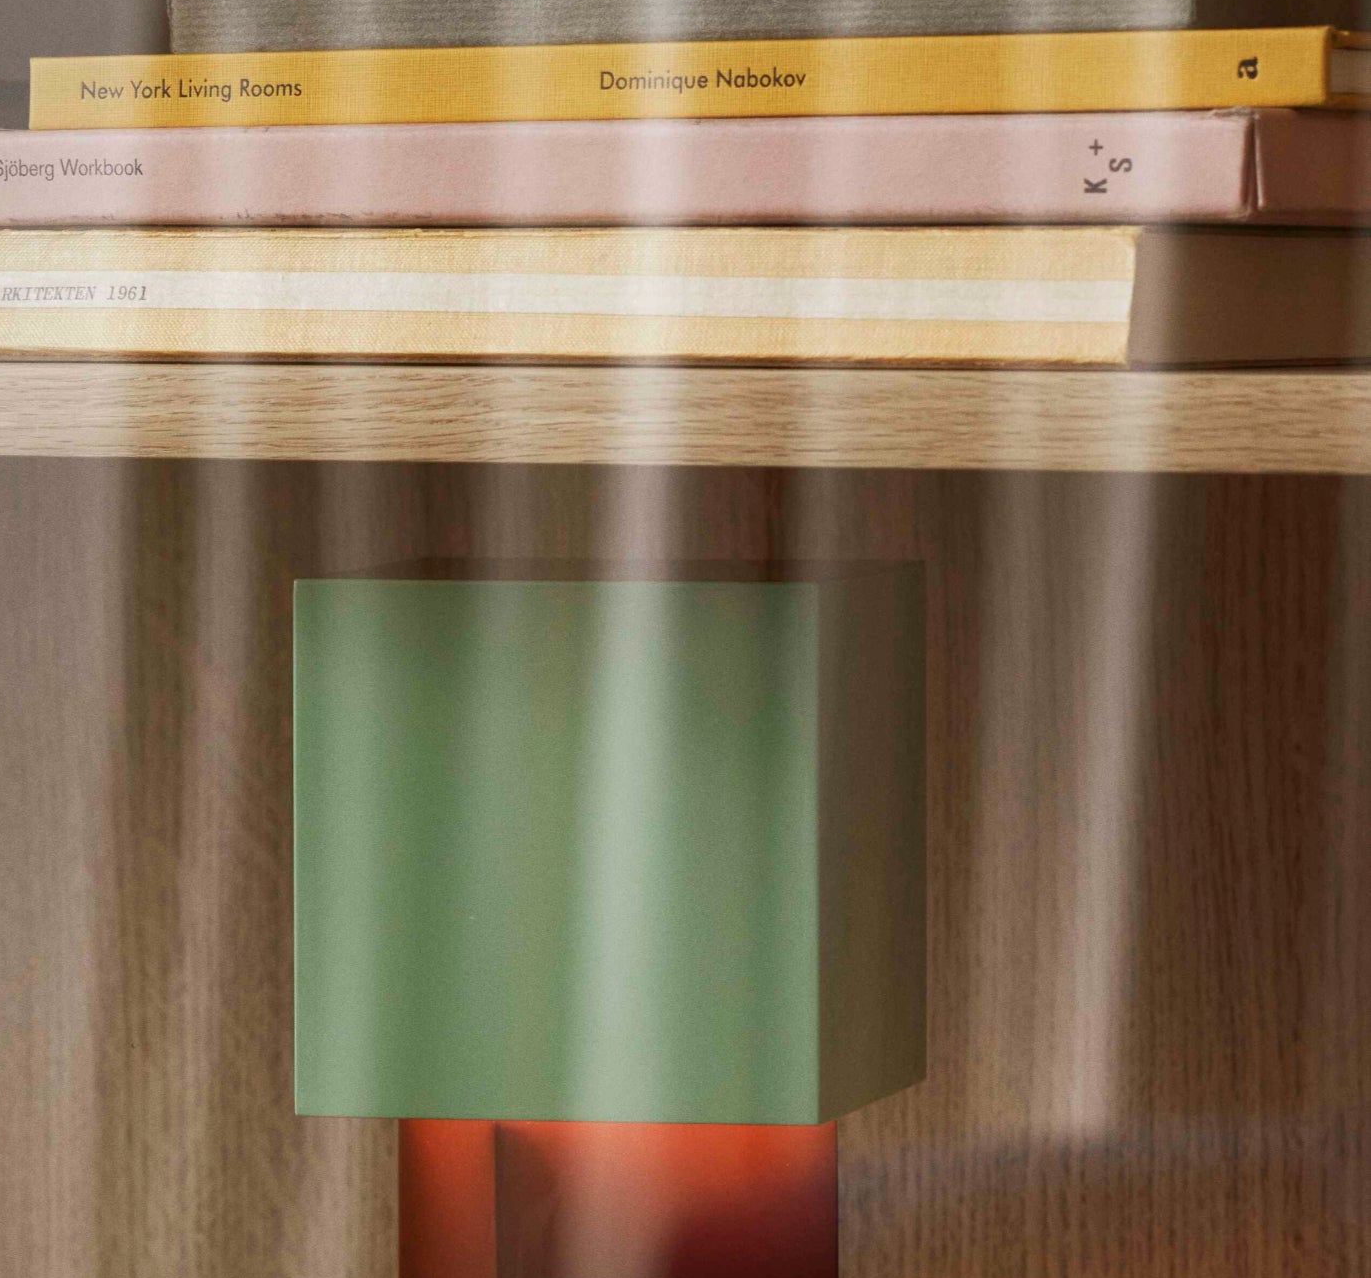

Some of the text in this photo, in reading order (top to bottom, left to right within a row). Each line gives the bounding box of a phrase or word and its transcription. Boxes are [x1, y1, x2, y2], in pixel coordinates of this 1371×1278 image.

[1237, 56, 1258, 79] a
[80, 78, 303, 102] New York Living Rooms
[599, 66, 807, 94] Dominique Nabokov
[59, 158, 144, 177] Workbook
[106, 285, 148, 301] 1961
